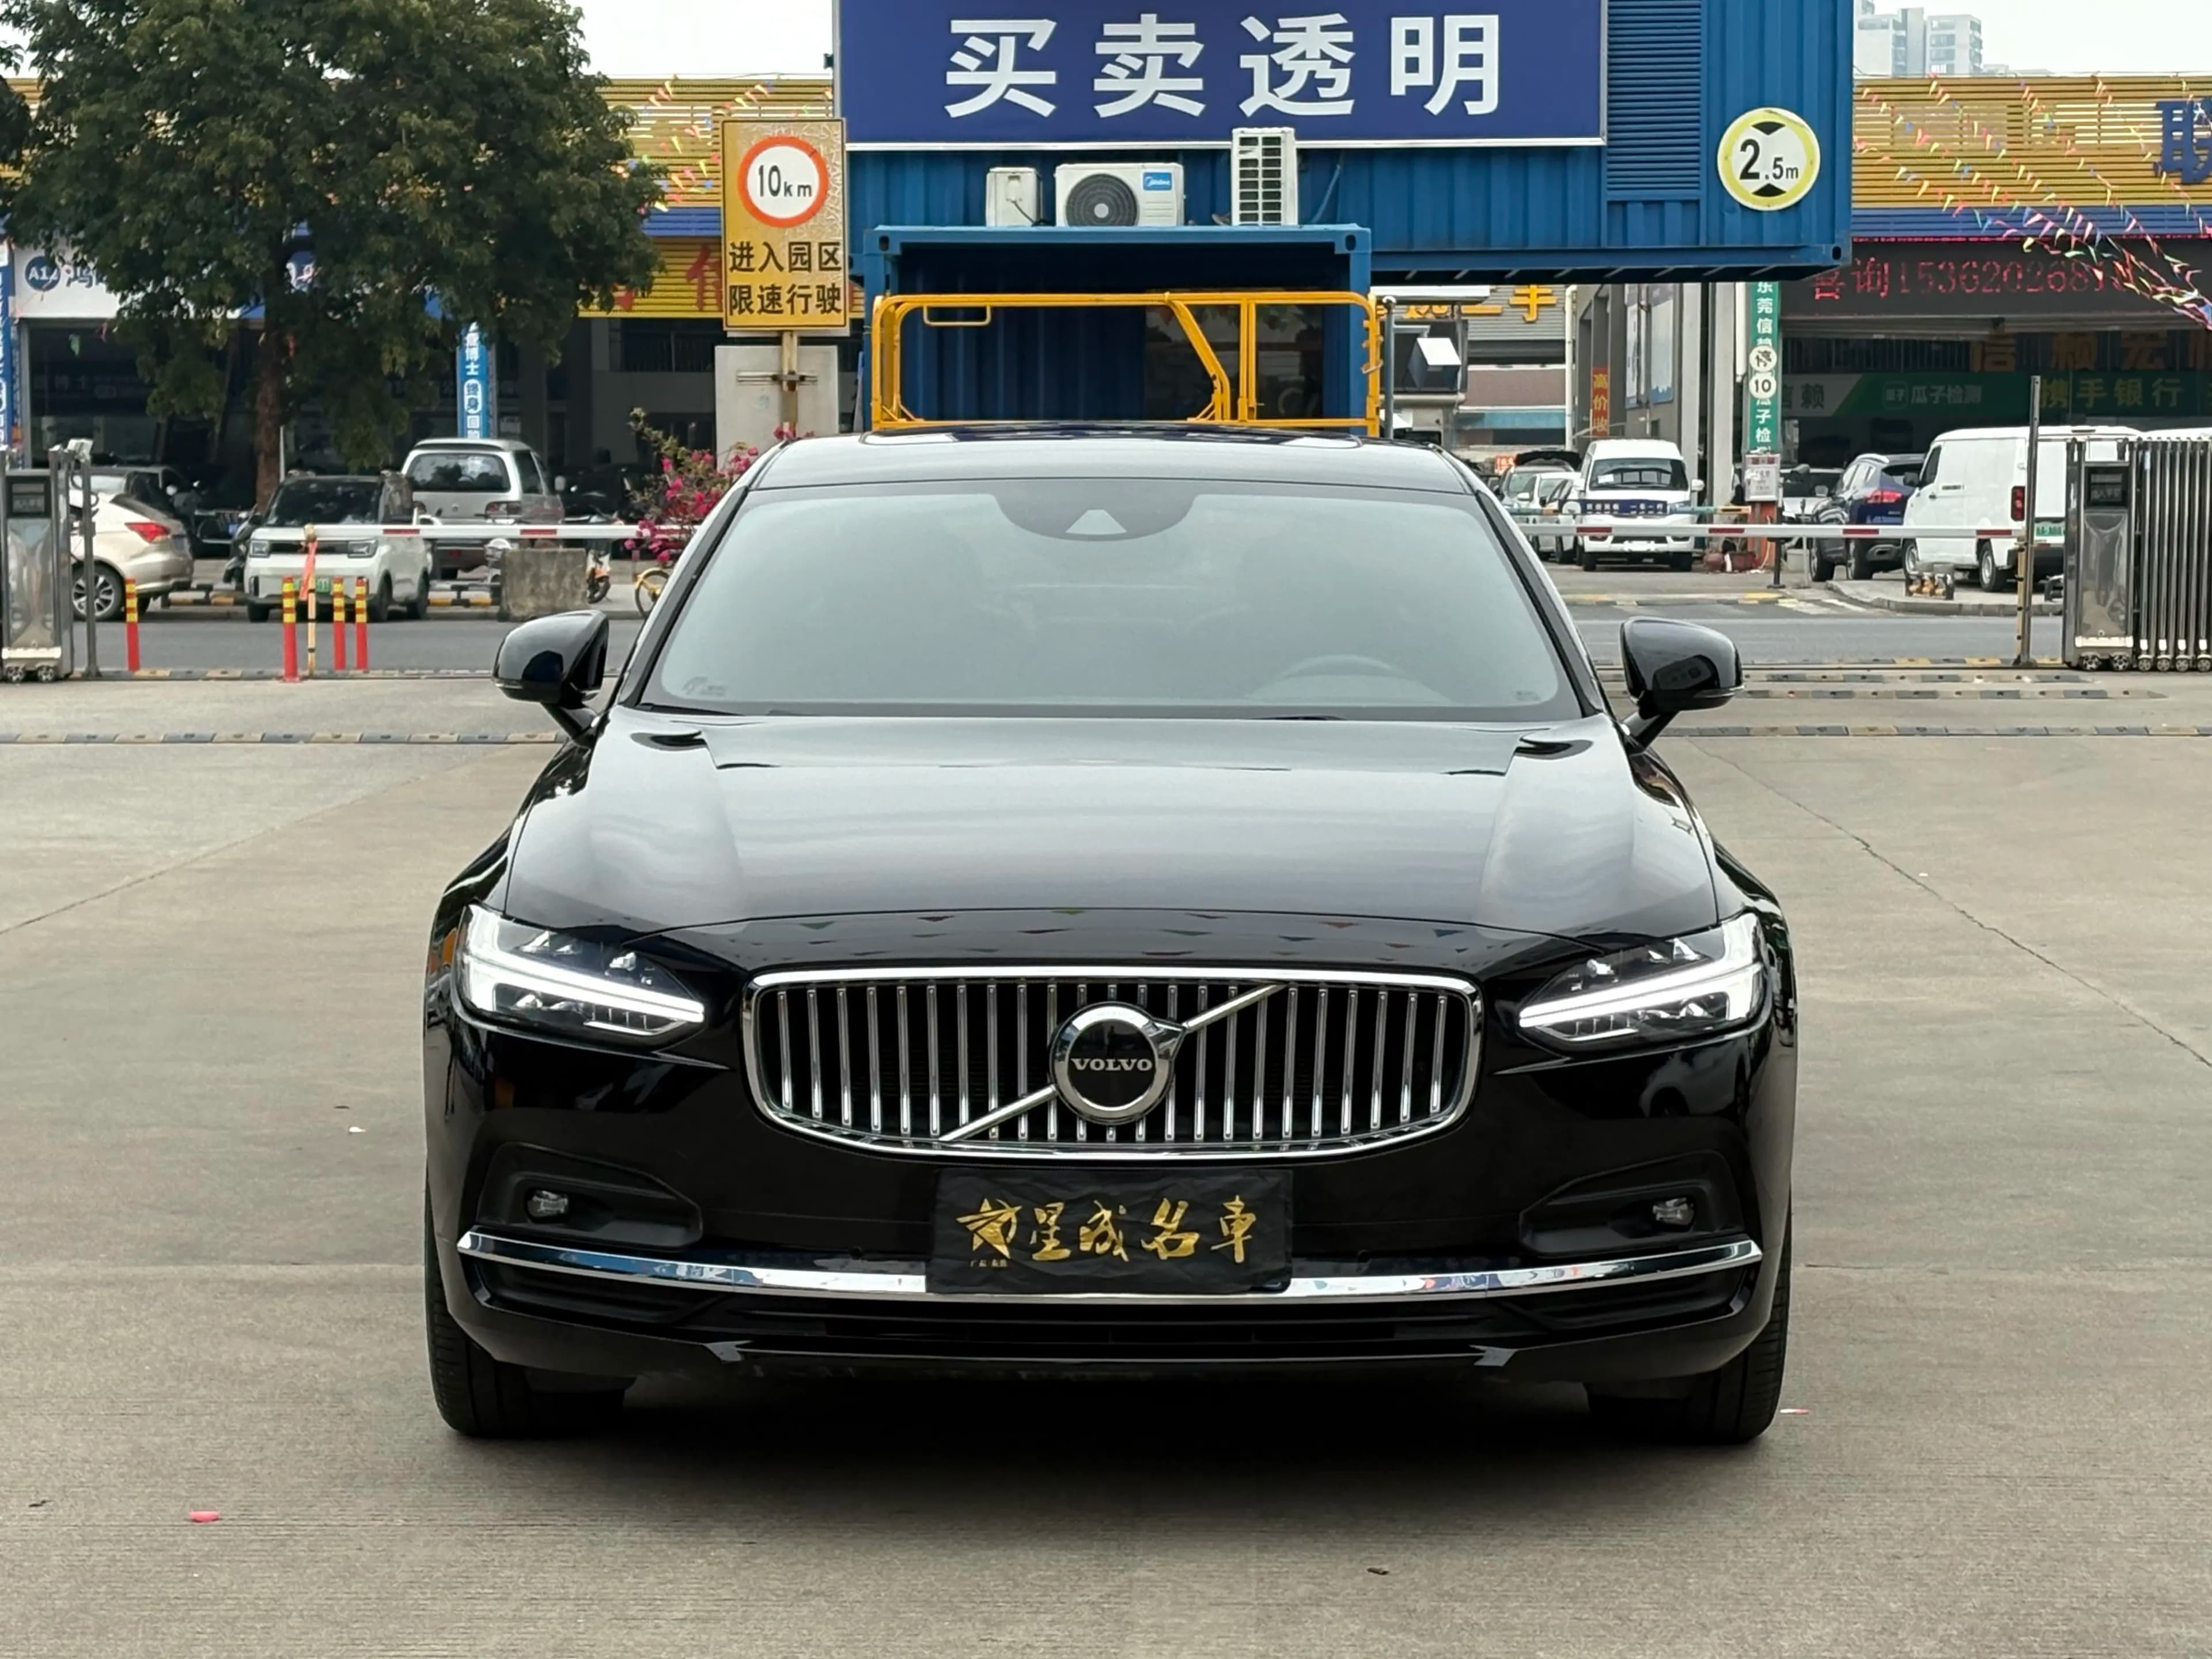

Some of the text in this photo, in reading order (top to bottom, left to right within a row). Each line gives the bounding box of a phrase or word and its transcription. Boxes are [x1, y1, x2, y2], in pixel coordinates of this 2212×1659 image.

[945, 13, 1499, 118] 买卖透明
[1740, 139, 1798, 180] 2.5m
[759, 165, 812, 197] 10km
[729, 241, 842, 272] 进入园区
[729, 283, 842, 316] 限速行驶
[1755, 379, 1772, 393] 10
[1071, 1058, 1153, 1071] VOLVO
